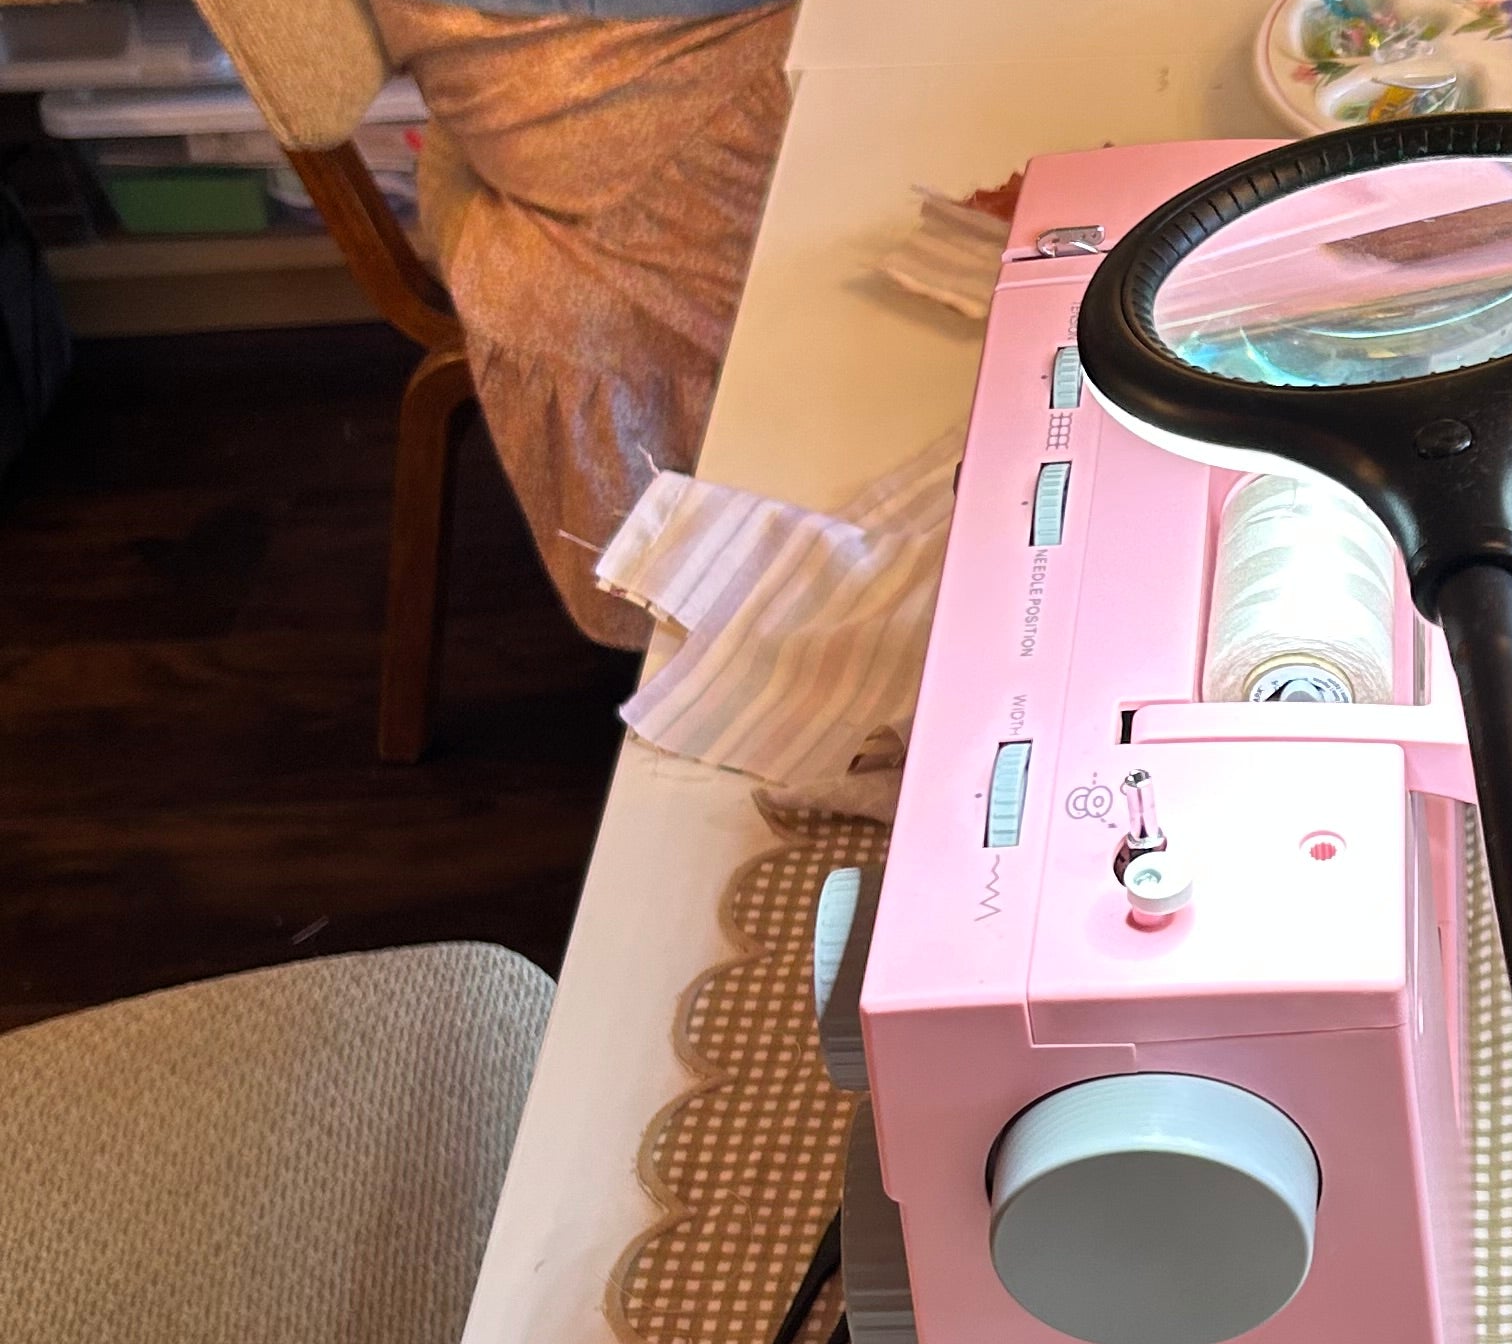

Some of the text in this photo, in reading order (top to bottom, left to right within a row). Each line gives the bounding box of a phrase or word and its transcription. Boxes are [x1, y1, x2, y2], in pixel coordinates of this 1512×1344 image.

[1020, 549, 1048, 657] NEEDLE POSITION
[1009, 694, 1028, 736] WIDTH
